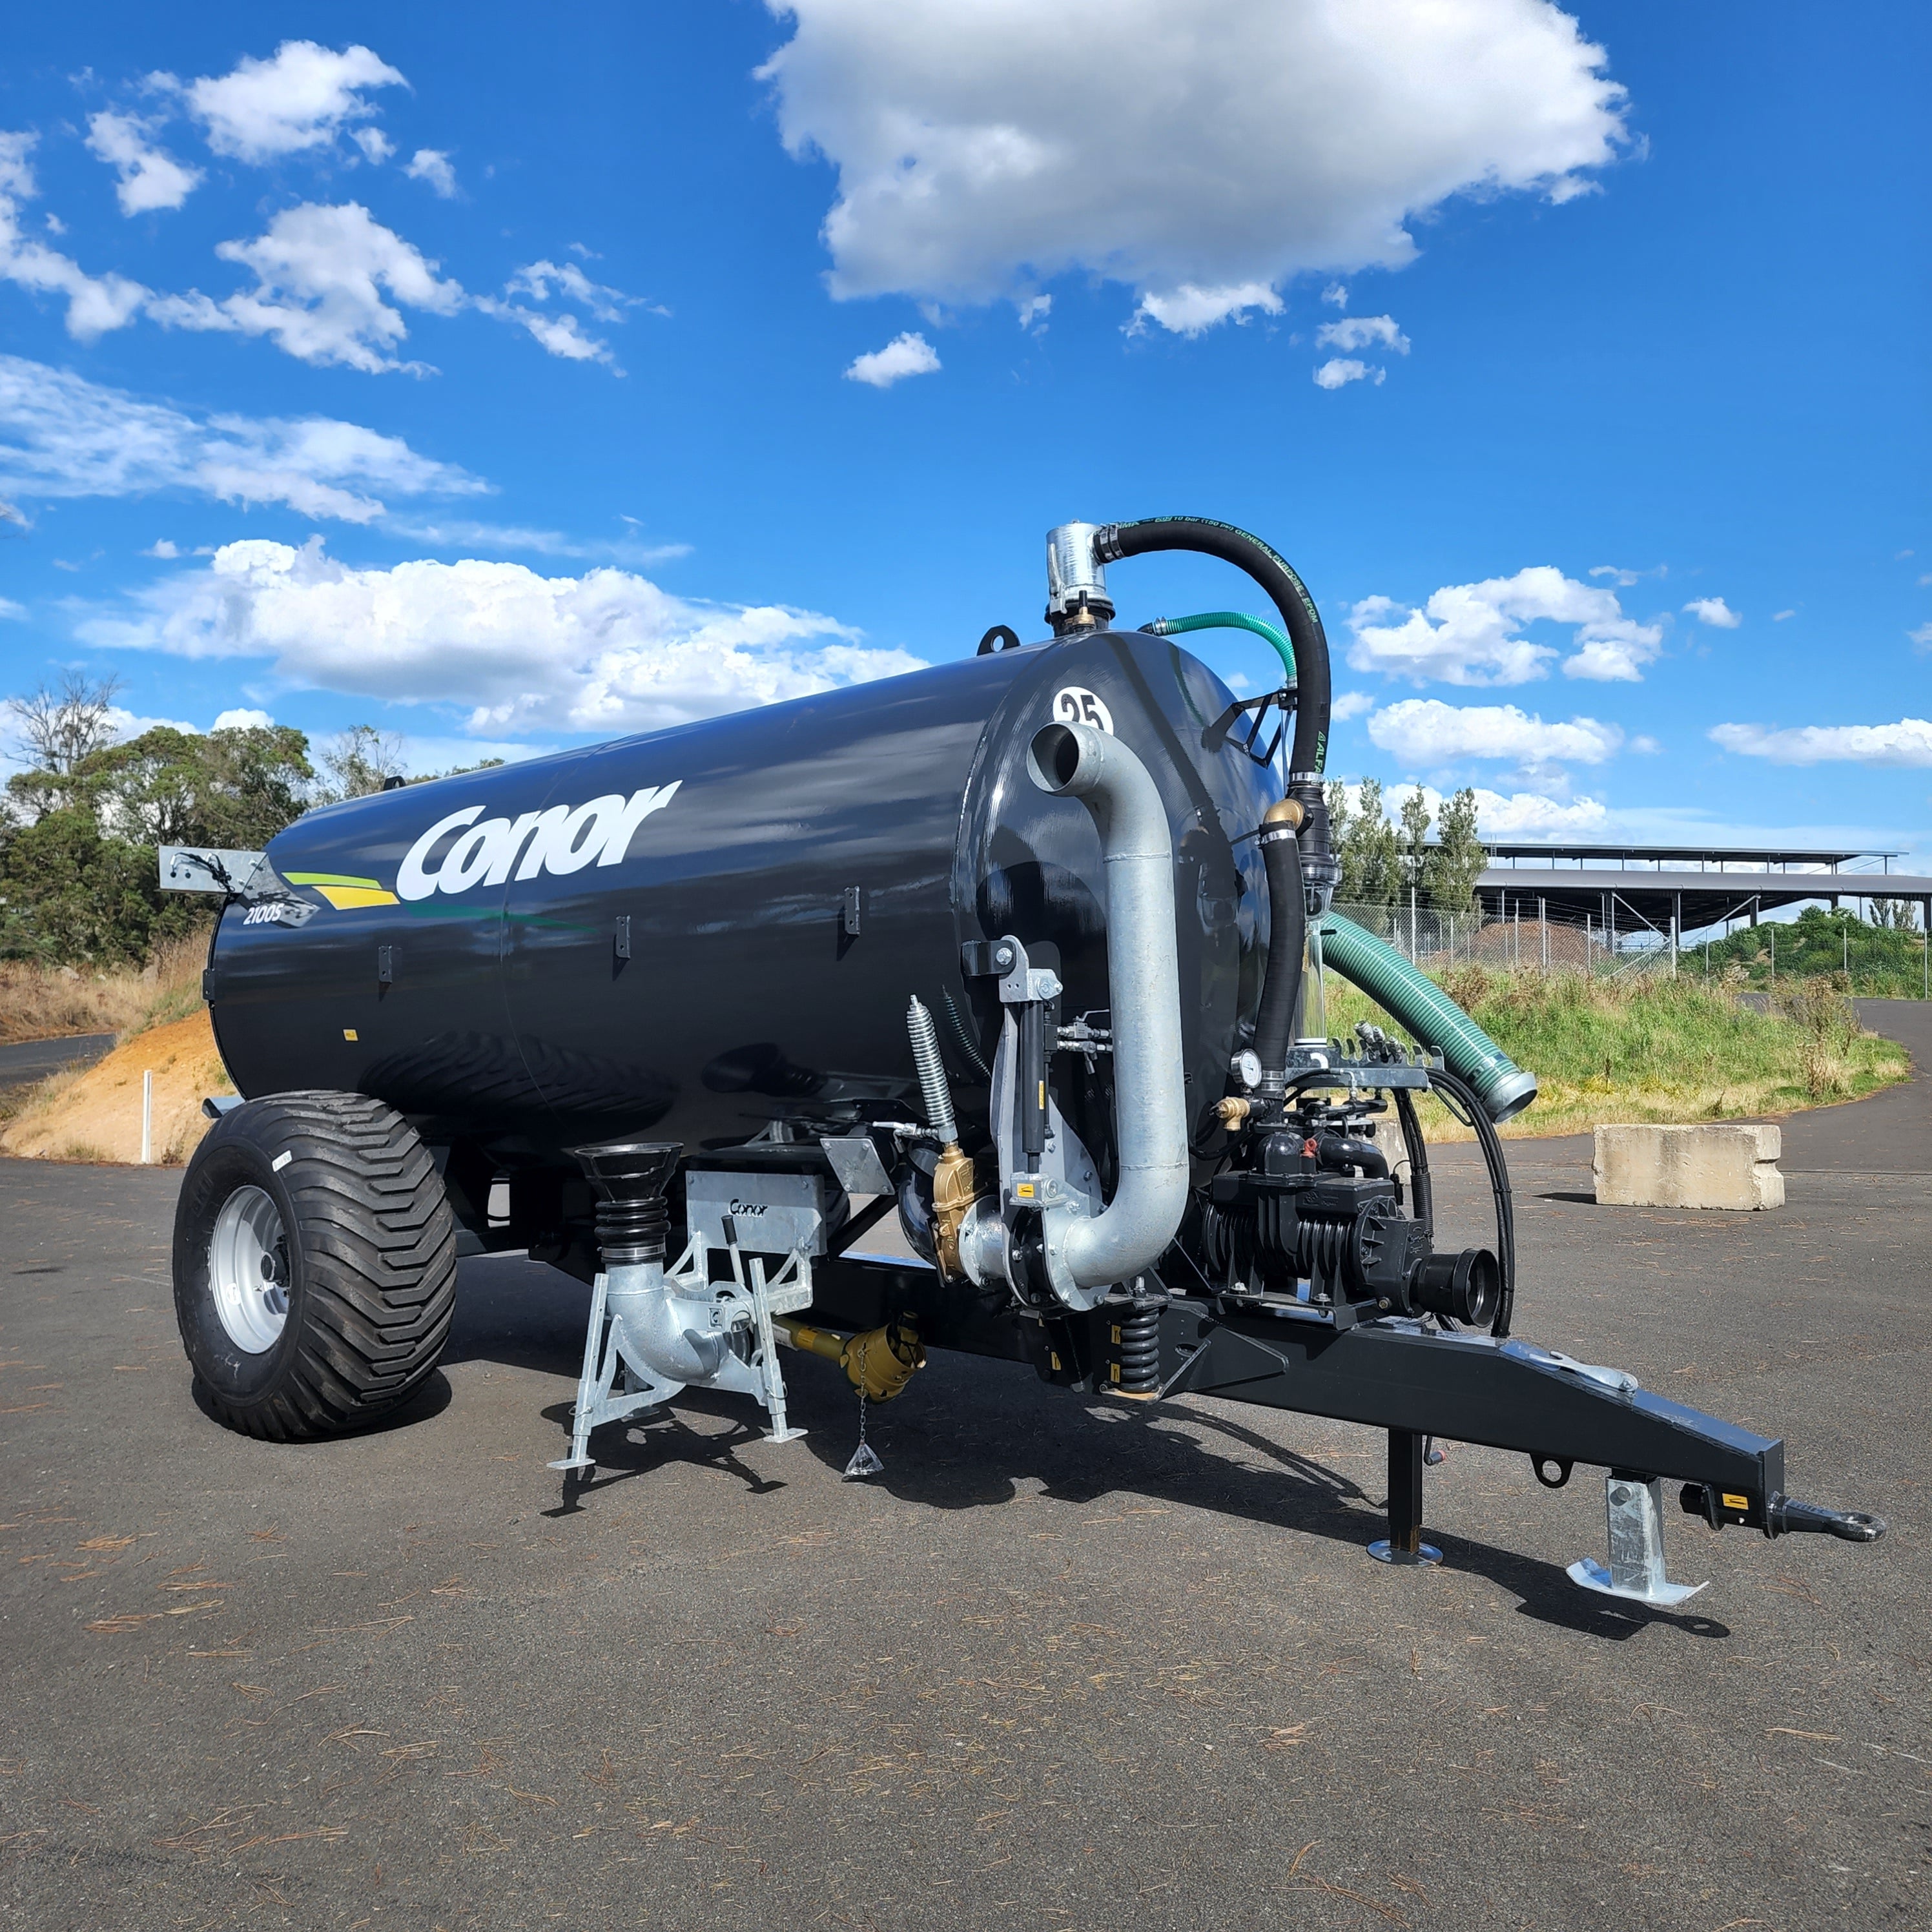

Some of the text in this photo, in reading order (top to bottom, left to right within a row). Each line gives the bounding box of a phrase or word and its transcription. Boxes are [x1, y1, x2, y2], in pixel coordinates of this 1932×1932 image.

[1235, 528, 1273, 555] GENERAL
[1273, 554, 1305, 593] PURPOSE
[1304, 597, 1319, 624] EPDM
[1061, 693, 1105, 732] 25
[396, 779, 683, 901] Conor
[730, 1198, 768, 1217] Conor
